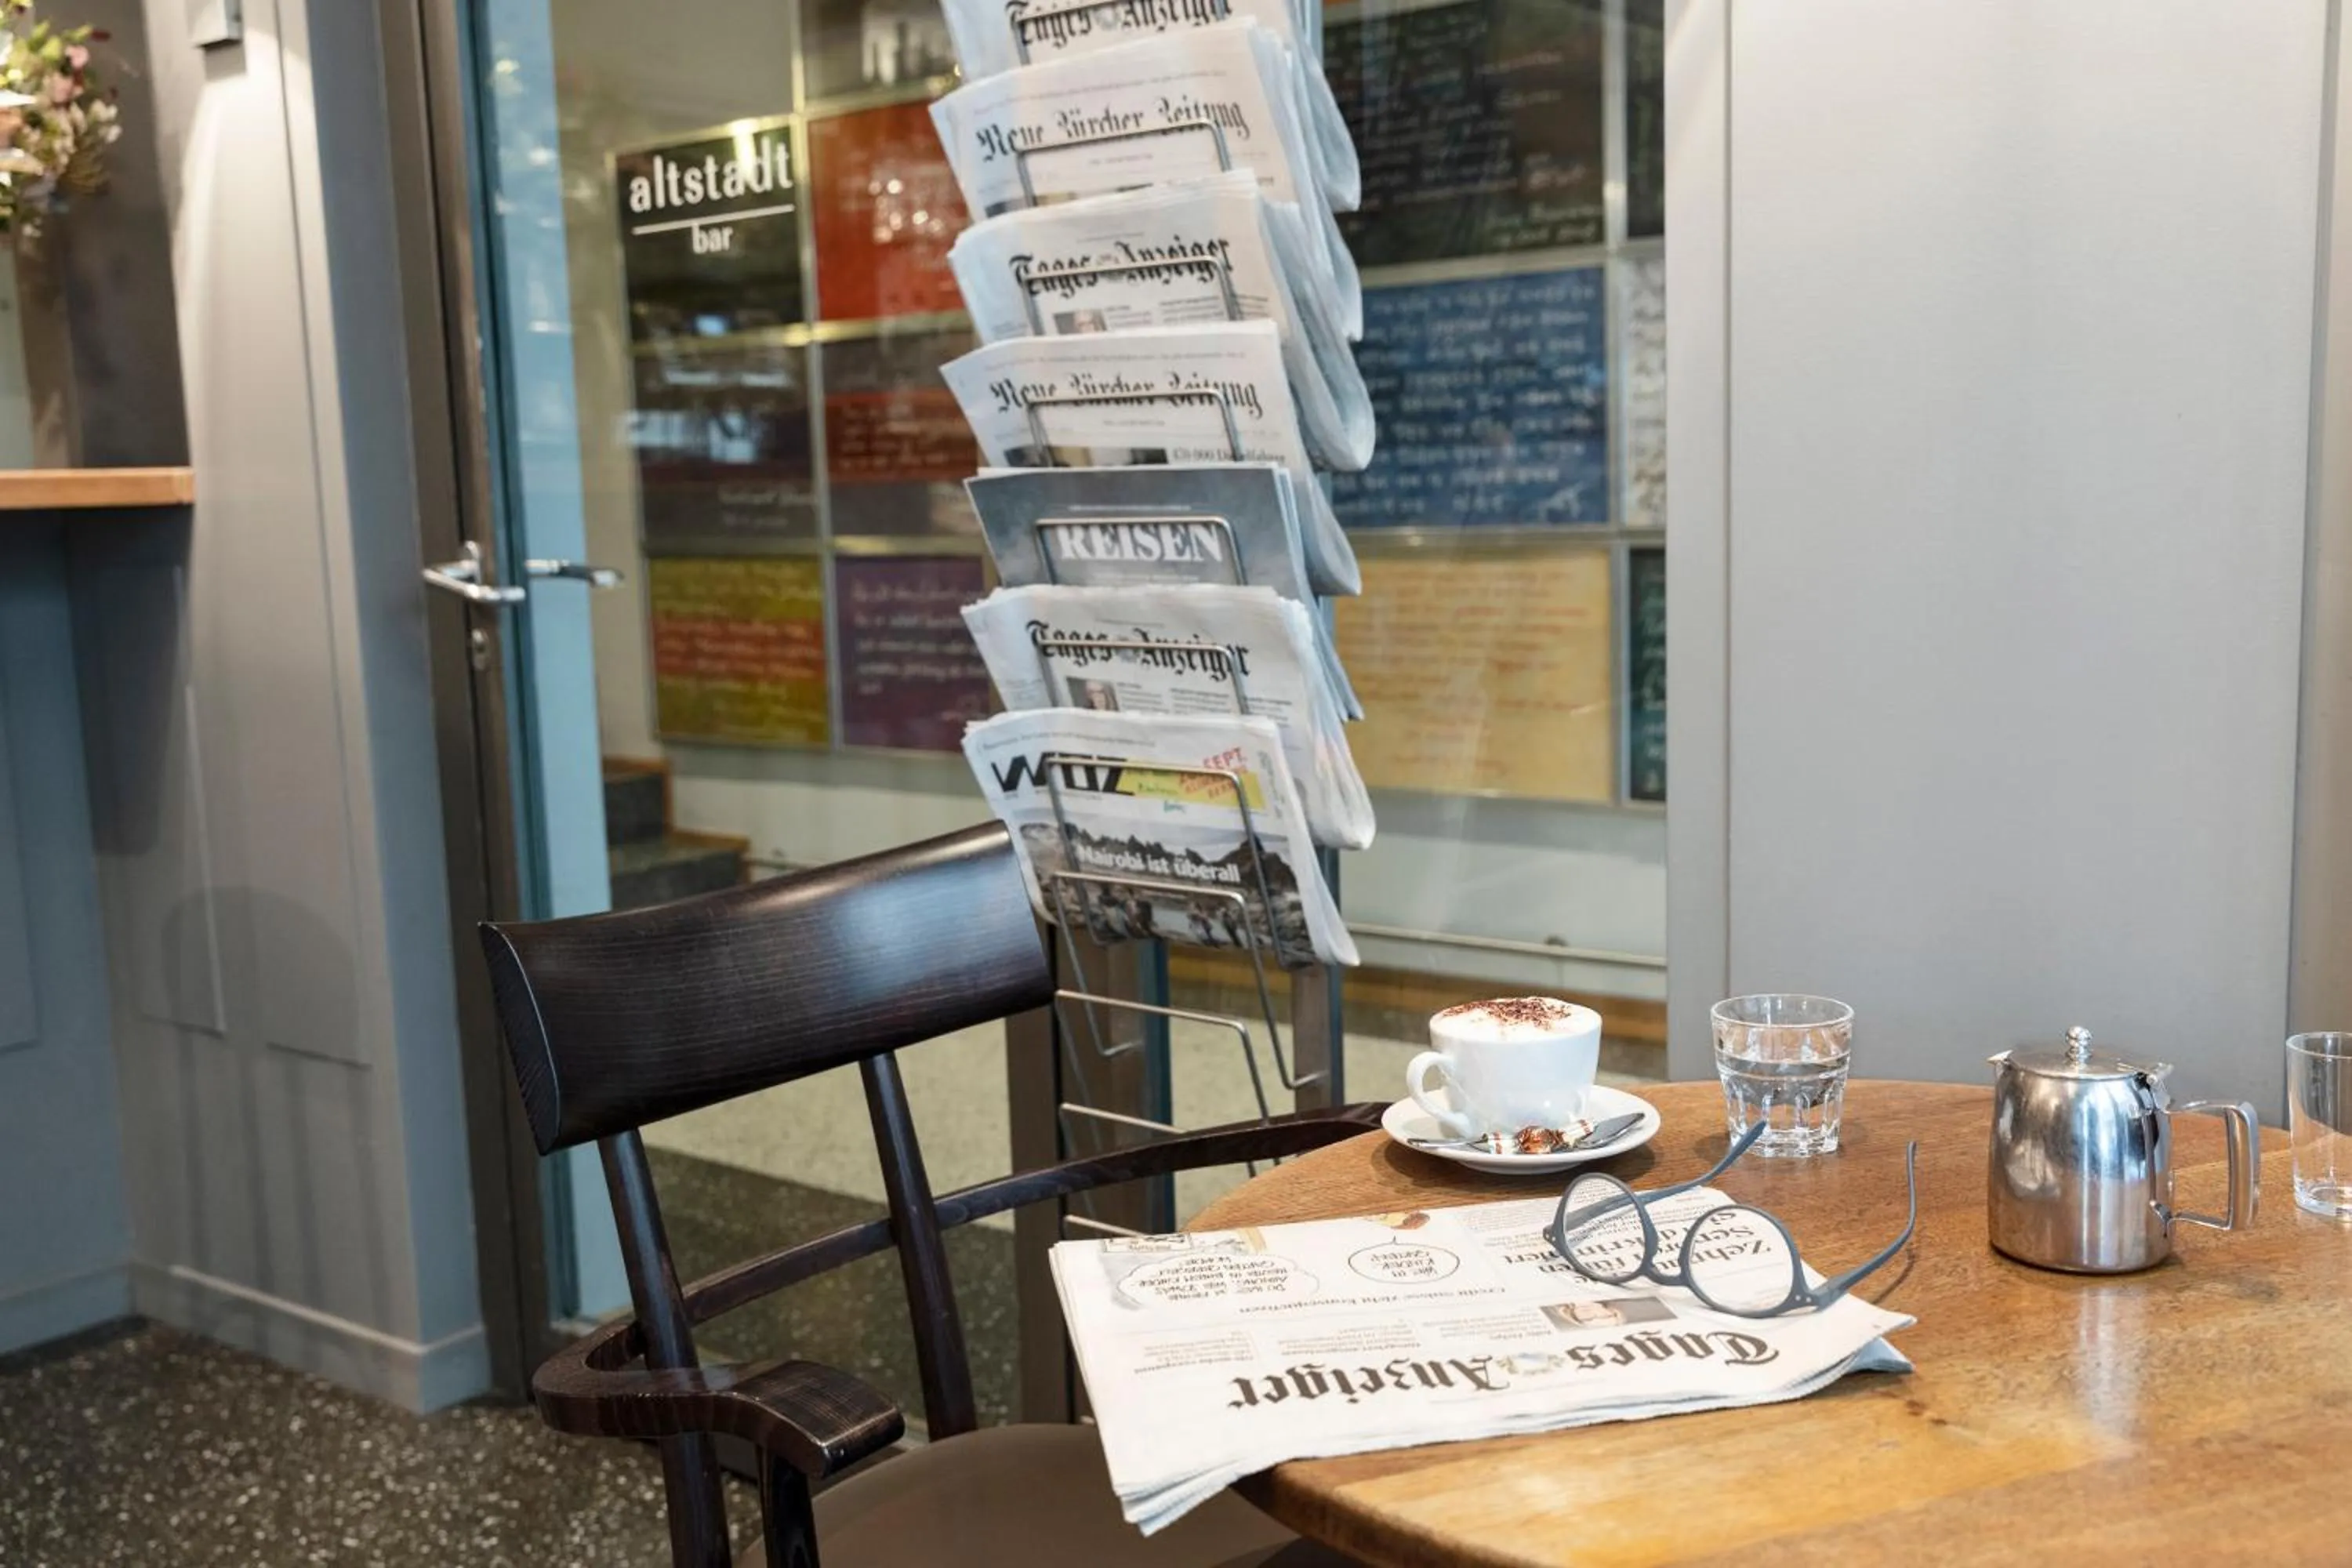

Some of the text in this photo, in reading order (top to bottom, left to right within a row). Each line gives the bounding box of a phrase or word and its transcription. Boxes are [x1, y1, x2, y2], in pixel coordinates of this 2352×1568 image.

[976, 95, 1250, 162] Neue Zürcher Zeitung
[630, 136, 793, 213] altstadt
[691, 223, 733, 254] bar
[989, 373, 1057, 413] Neue
[1056, 522, 1222, 562] REISEN
[1026, 620, 1251, 681] Tages Anzeiger
[1076, 844, 1241, 884] Nairobi ist überall
[1227, 1328, 1778, 1409] Tages Anzeiger
